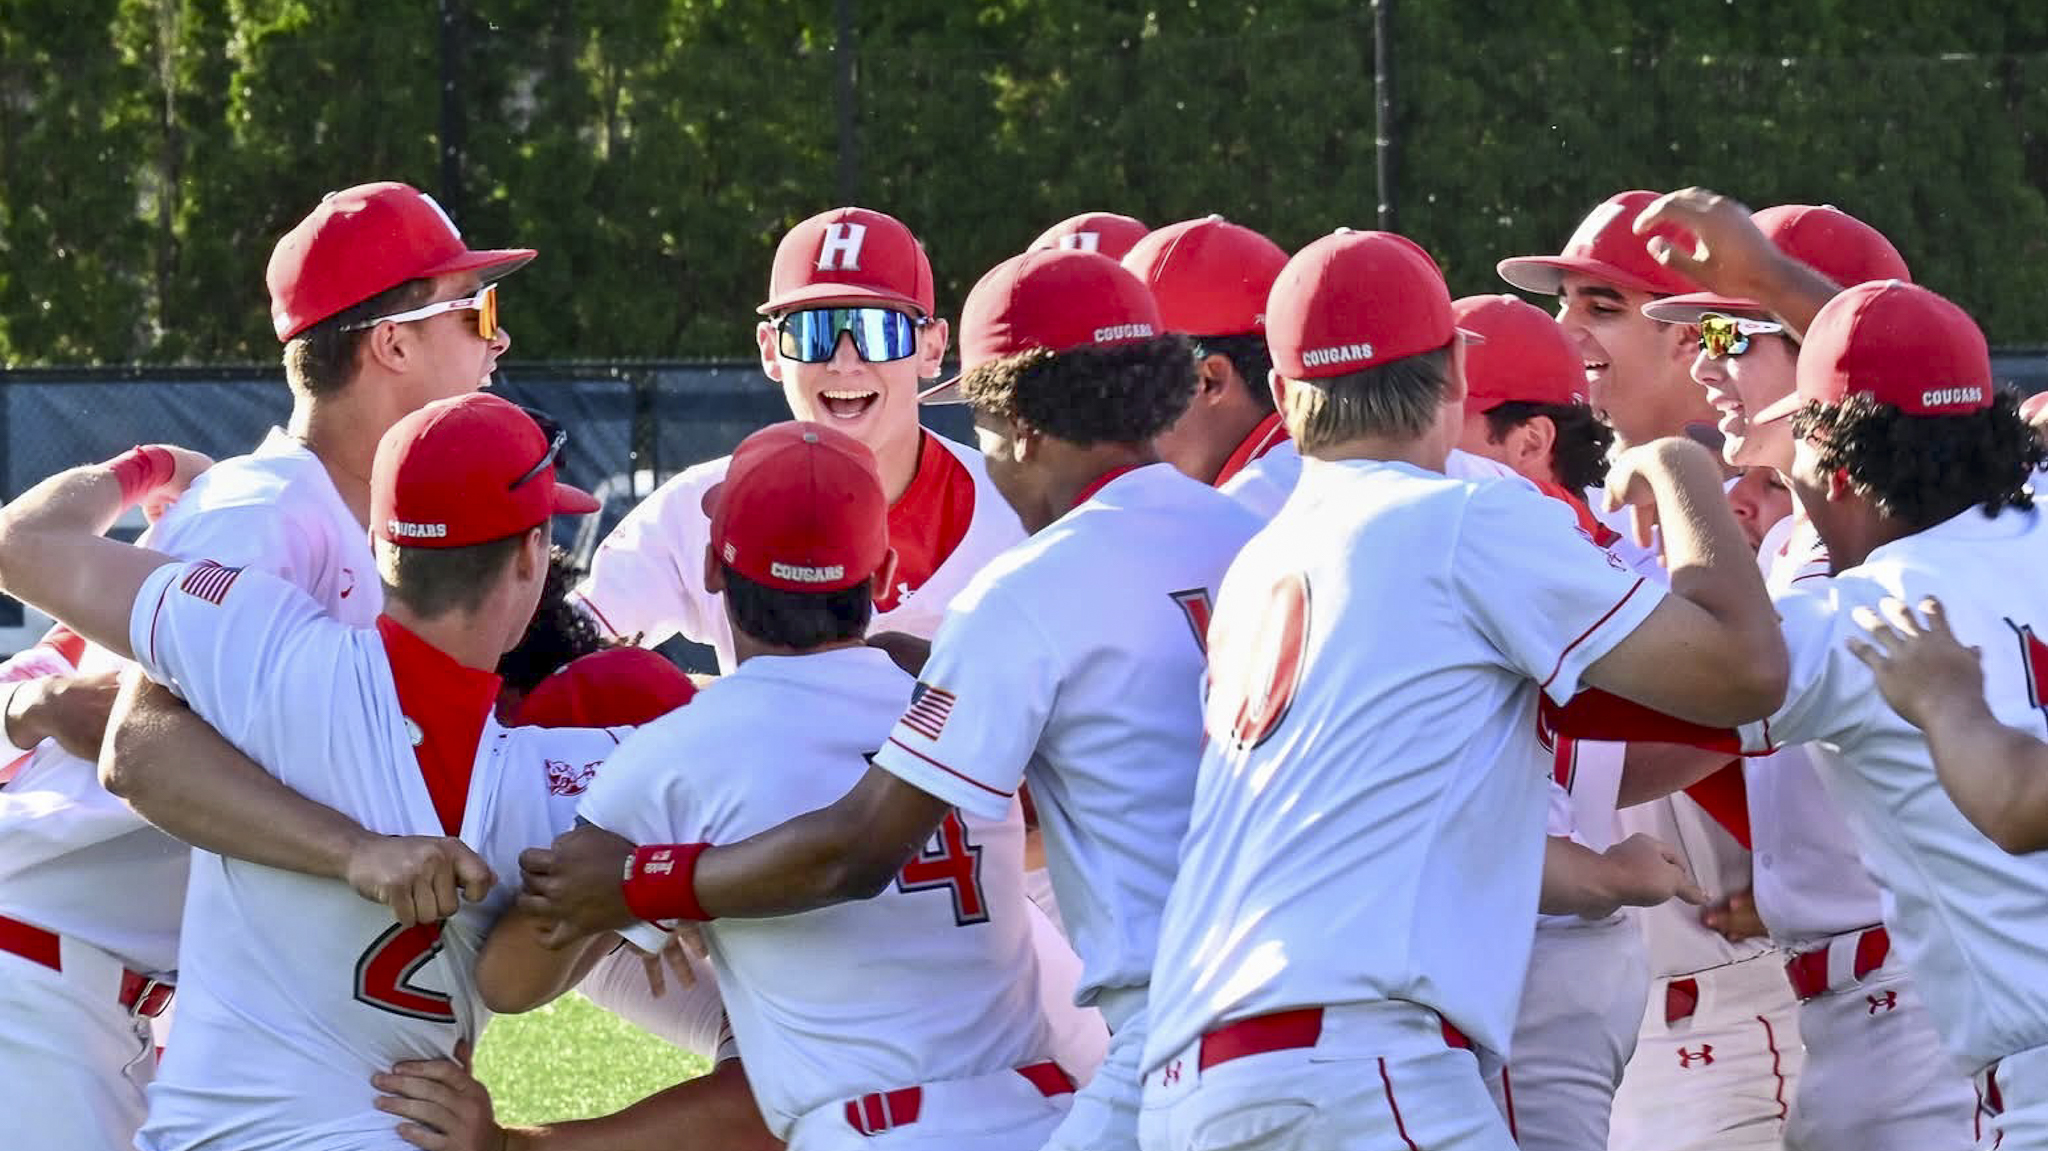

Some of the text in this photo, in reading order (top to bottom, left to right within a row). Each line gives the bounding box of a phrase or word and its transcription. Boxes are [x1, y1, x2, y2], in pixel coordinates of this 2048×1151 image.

[817, 222, 868, 272] H
[1302, 344, 1374, 367] COUGARS
[1922, 387, 1983, 407] COUGARS
[771, 562, 845, 583] COUGARS
